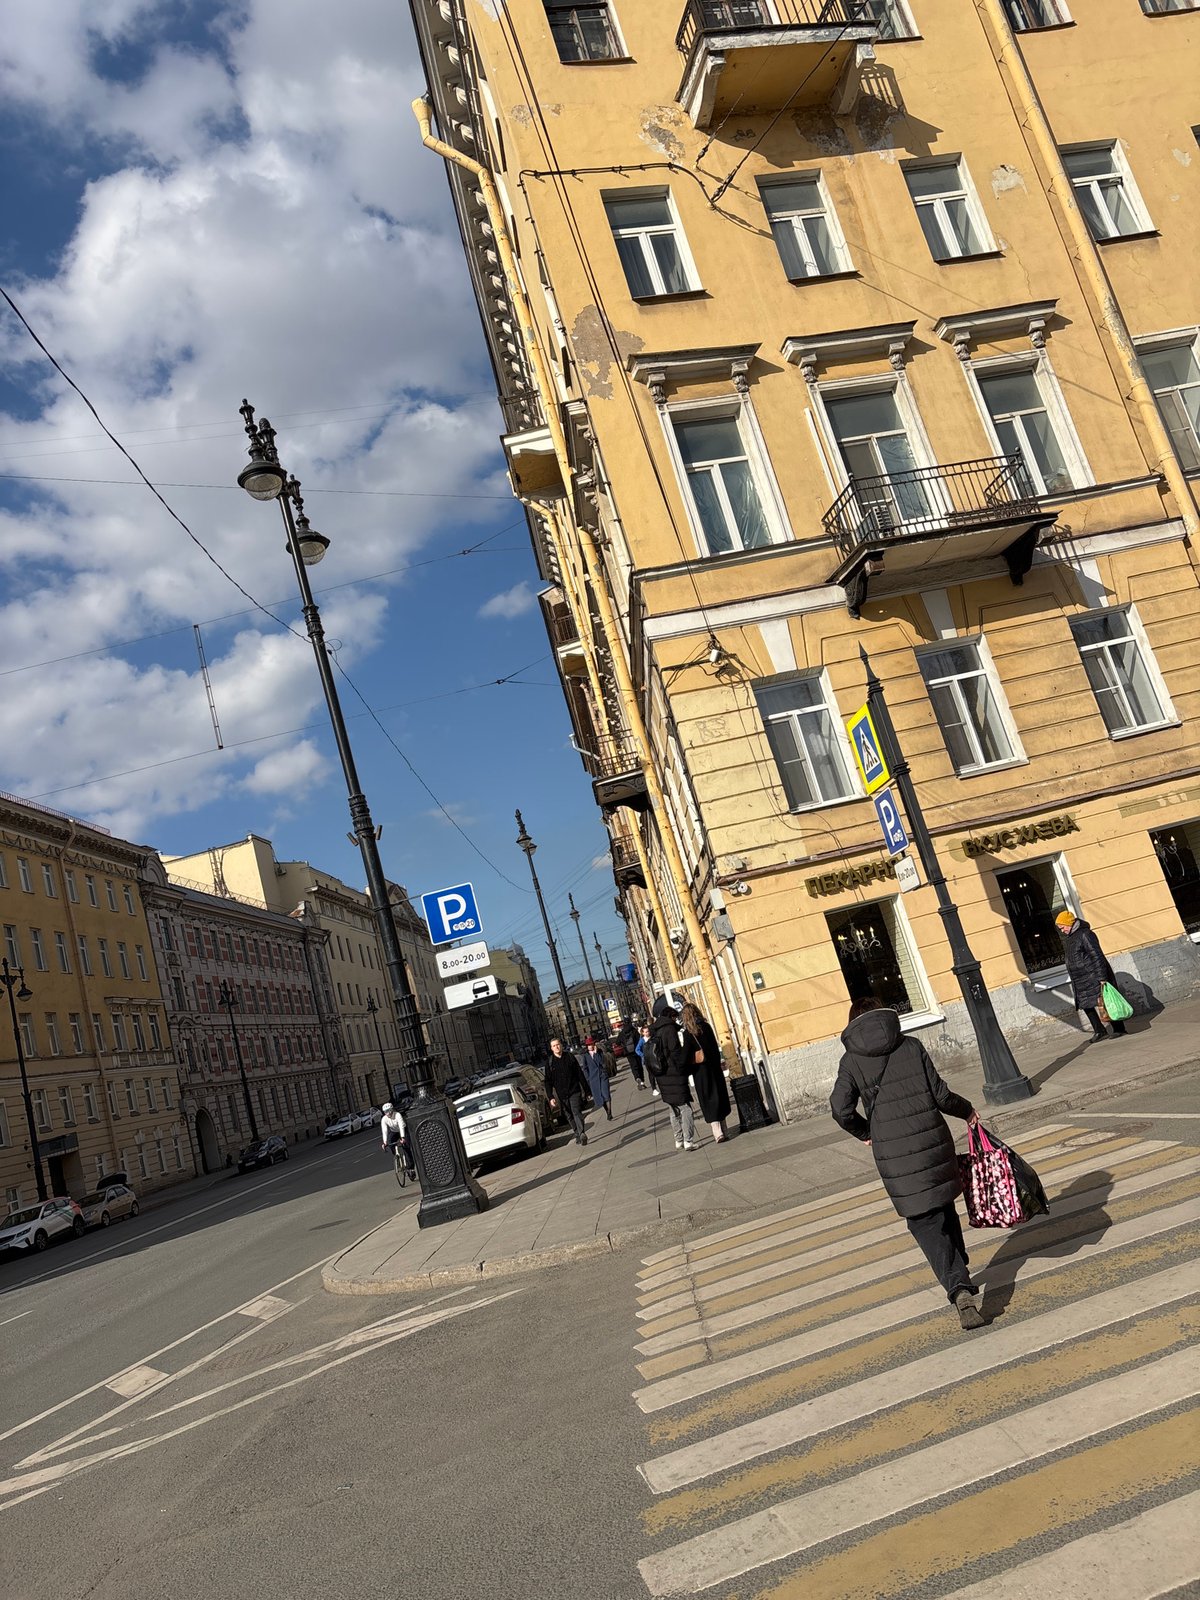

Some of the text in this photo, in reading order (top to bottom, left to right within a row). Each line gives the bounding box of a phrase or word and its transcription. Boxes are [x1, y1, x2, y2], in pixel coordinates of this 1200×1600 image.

[880, 799, 895, 847] P
[962, 815, 1080, 858] ВКУС ХЛЕБА
[437, 893, 467, 936] P
[442, 952, 486, 969] 8.00-20.00
